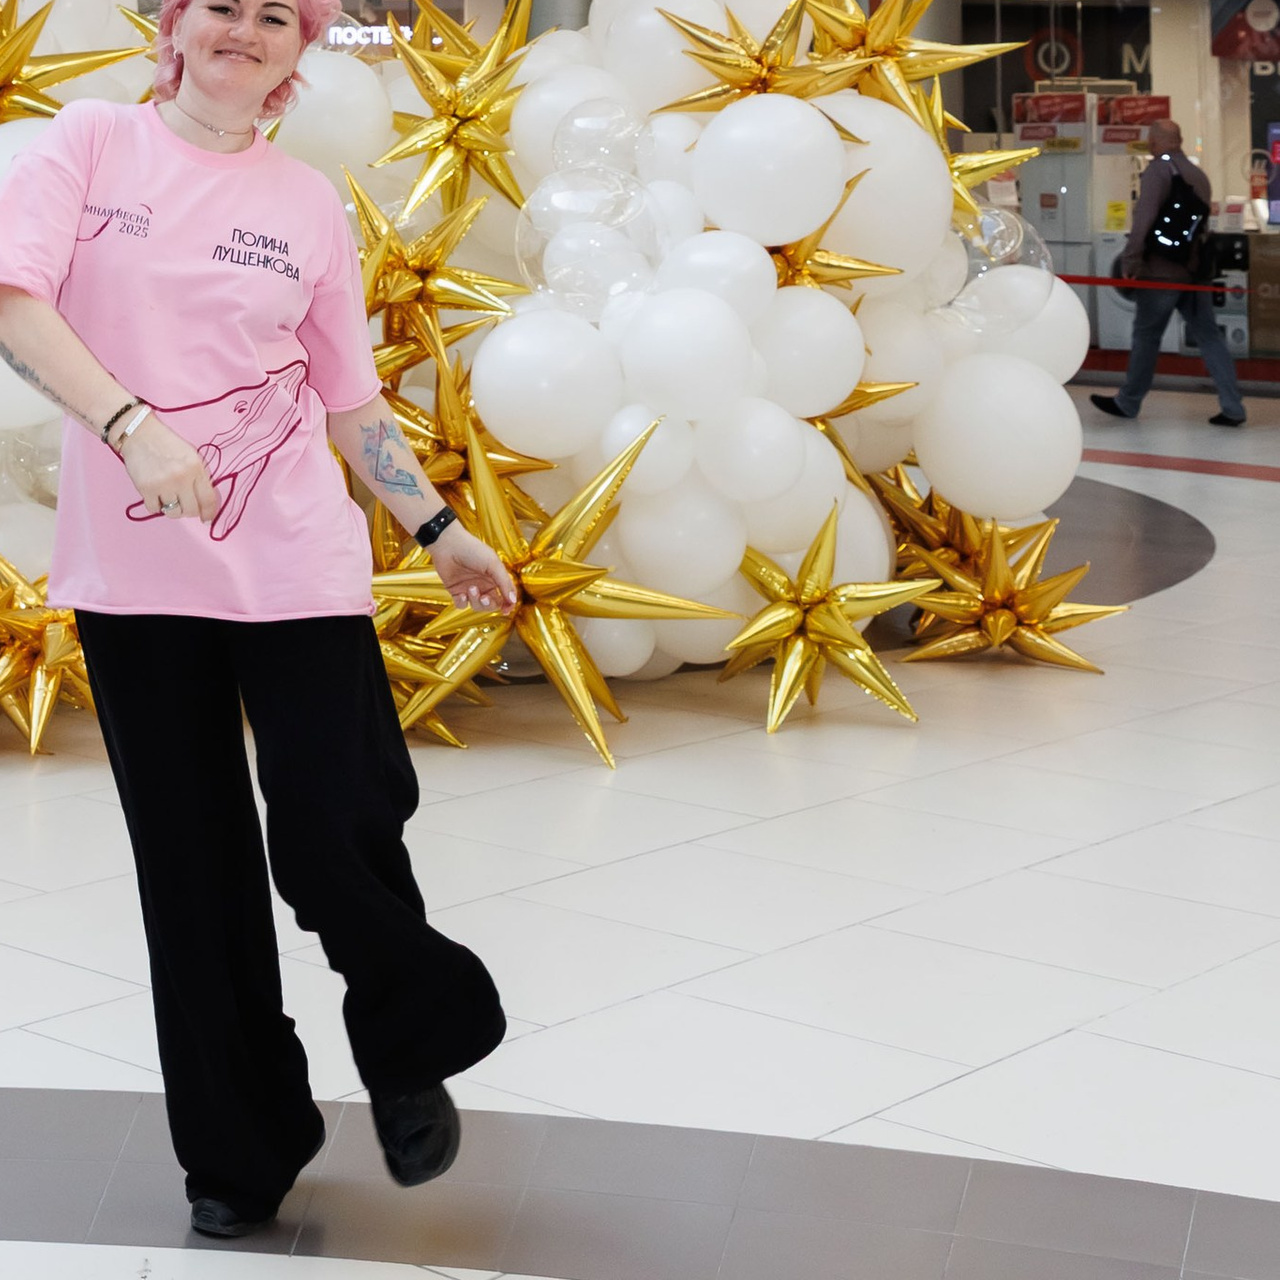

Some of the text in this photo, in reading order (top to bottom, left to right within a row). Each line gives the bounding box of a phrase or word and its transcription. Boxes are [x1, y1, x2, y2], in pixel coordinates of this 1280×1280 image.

[118, 221, 149, 239] 2025
[231, 228, 289, 257] ПОЛИНА
[212, 245, 300, 282] ЛУЩЕНКОВА
